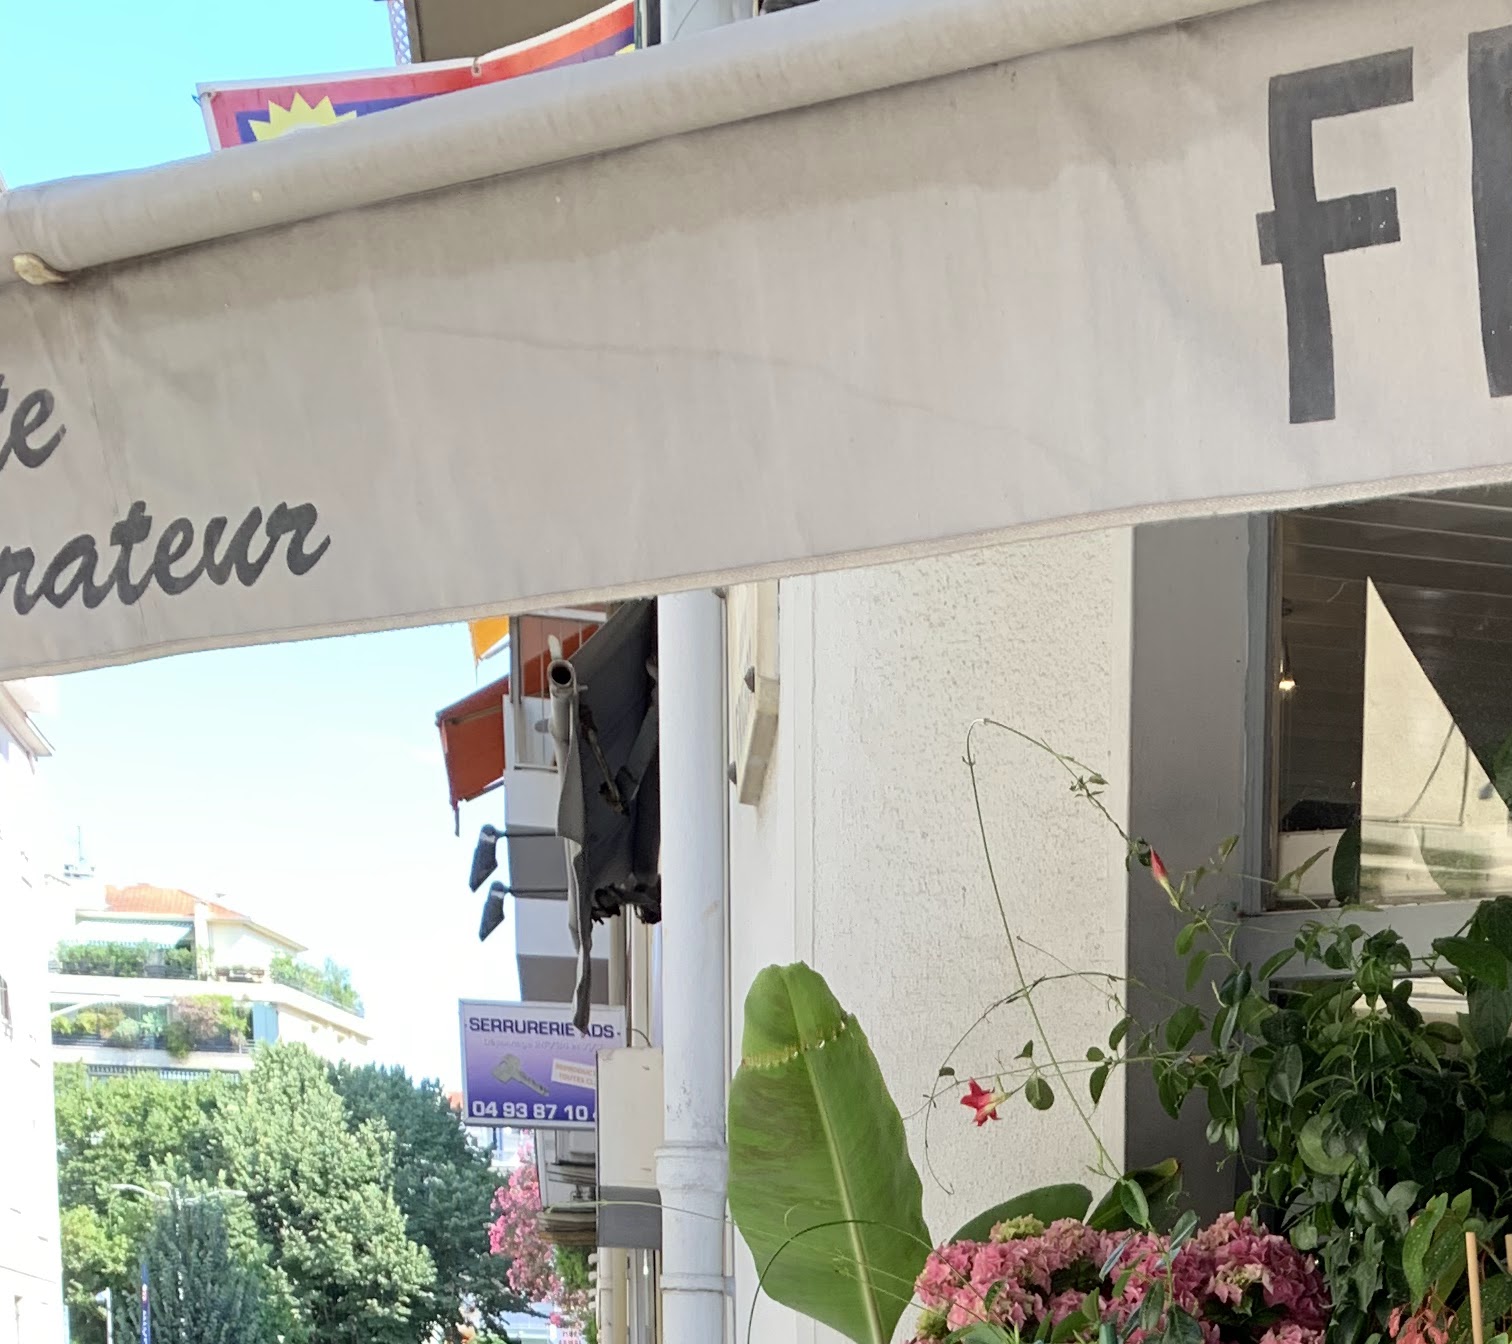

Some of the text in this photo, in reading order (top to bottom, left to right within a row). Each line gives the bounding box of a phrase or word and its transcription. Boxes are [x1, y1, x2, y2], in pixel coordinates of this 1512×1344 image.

[469, 1018, 575, 1037] SERRURERIE
[472, 1101, 498, 1117] 04
[503, 1102, 528, 1118] 93
[533, 1103, 557, 1120] 87
[564, 1105, 588, 1121] 10
